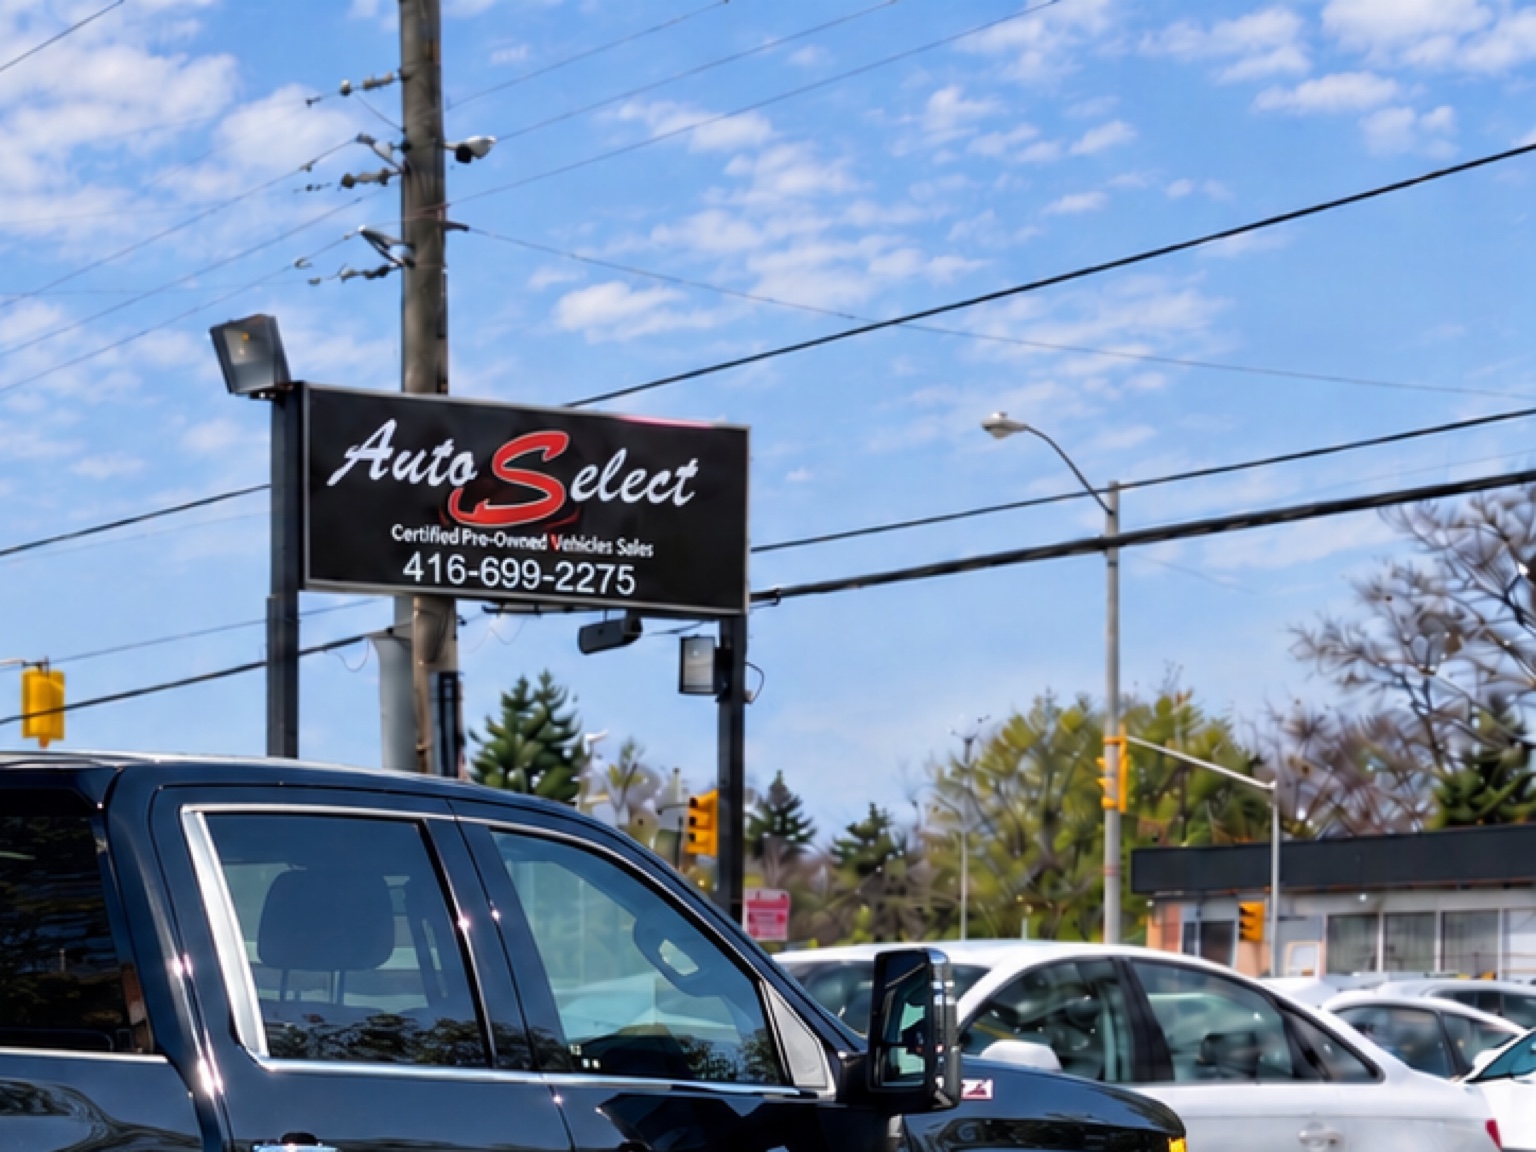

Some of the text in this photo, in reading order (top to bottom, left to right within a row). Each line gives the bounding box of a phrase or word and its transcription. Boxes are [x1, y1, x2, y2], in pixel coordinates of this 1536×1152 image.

[391, 523, 655, 558] Certified Pre-Owned Vehicles Sales
[402, 551, 636, 596] 416-699-2275
